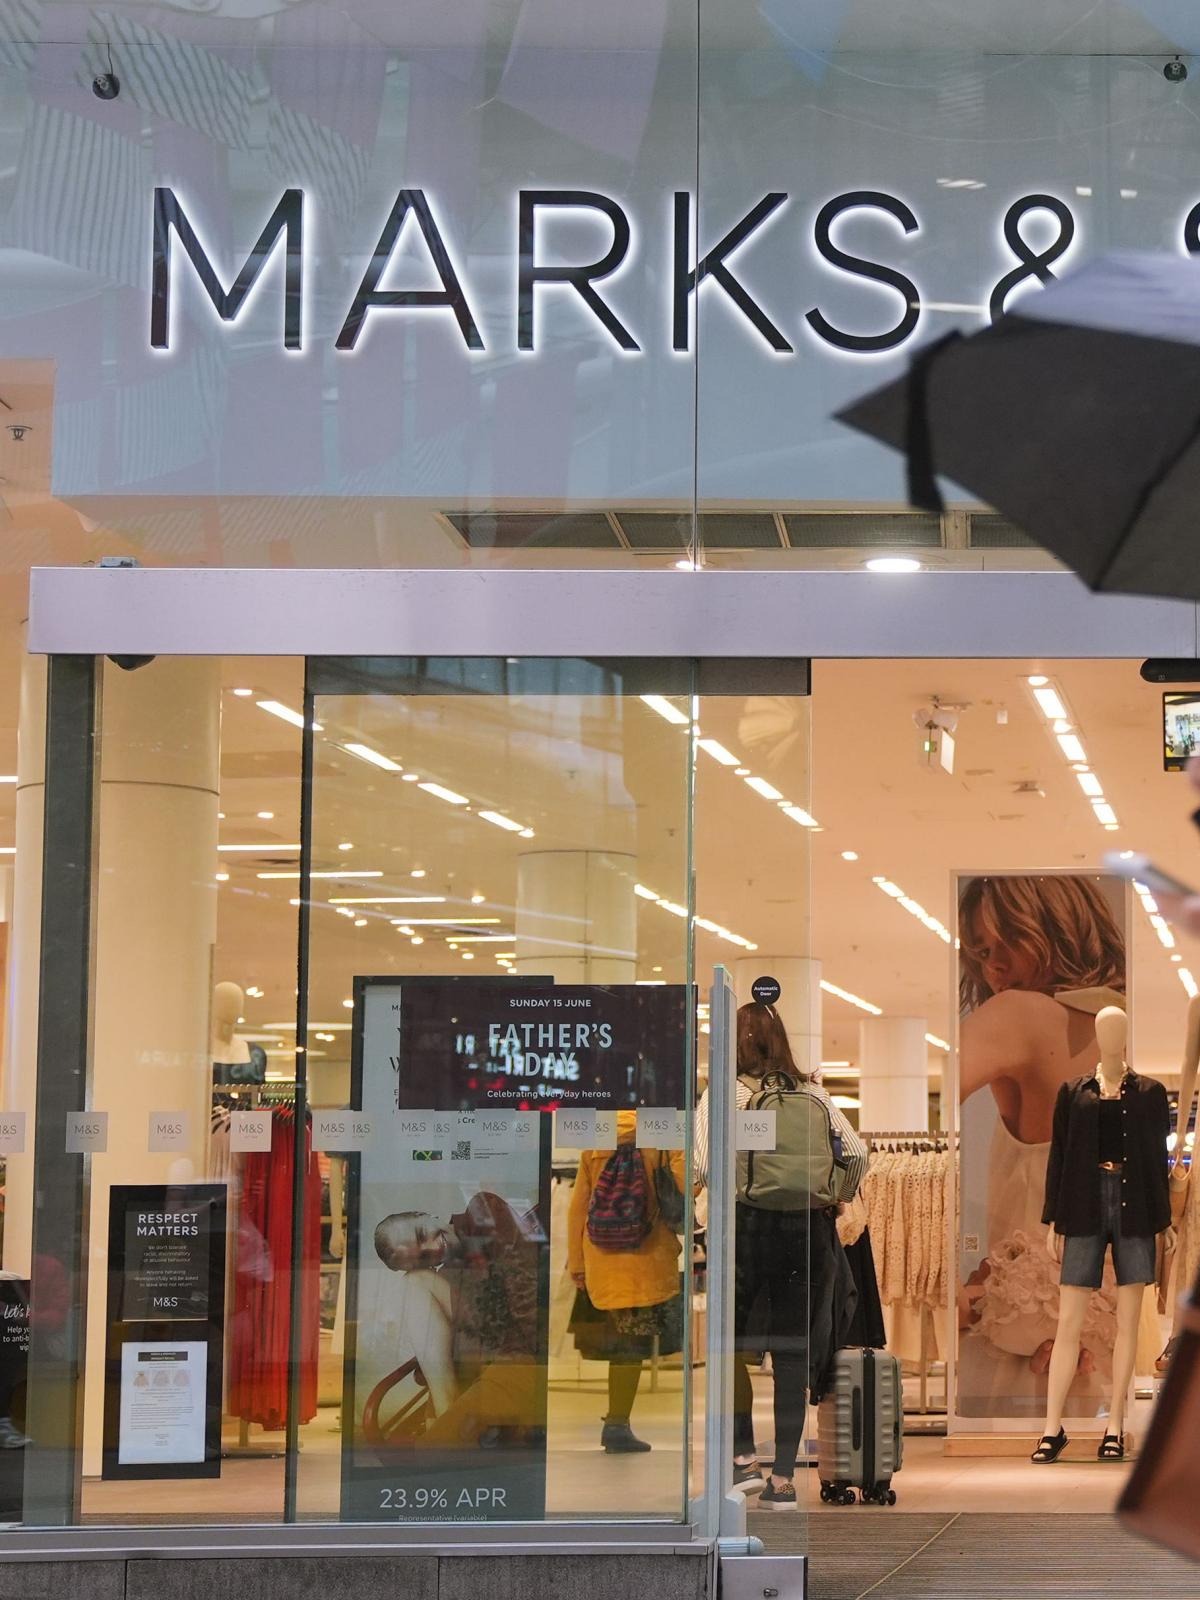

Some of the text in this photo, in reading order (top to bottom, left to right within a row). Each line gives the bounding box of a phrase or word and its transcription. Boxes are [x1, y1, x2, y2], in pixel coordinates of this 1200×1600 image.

[151, 187, 922, 353] MARKS
[989, 193, 1076, 327] &
[509, 999, 591, 1007] SUNDAY 15 JUNE
[488, 1023, 612, 1048] FATHER'S
[525, 1052, 576, 1077] DAY
[487, 1090, 538, 1099] Celebrating
[540, 1090, 580, 1099] everyday
[74, 1125, 100, 1134] M&S
[157, 1124, 182, 1134] M&S
[238, 1124, 264, 1133] M&S
[320, 1123, 345, 1133] M&S
[401, 1122, 426, 1131] M&S
[482, 1121, 507, 1131] M&S
[563, 1121, 588, 1130] M&S
[644, 1120, 669, 1129] M&S
[744, 1123, 768, 1132] M&S
[138, 1213, 198, 1223] RESPECT
[137, 1226, 198, 1236] MATTERS
[153, 1296, 177, 1307] M&S
[4, 1304, 24, 1319] Let's
[7, 1326, 22, 1334] Help
[379, 1488, 507, 1508] 23.9% APR
